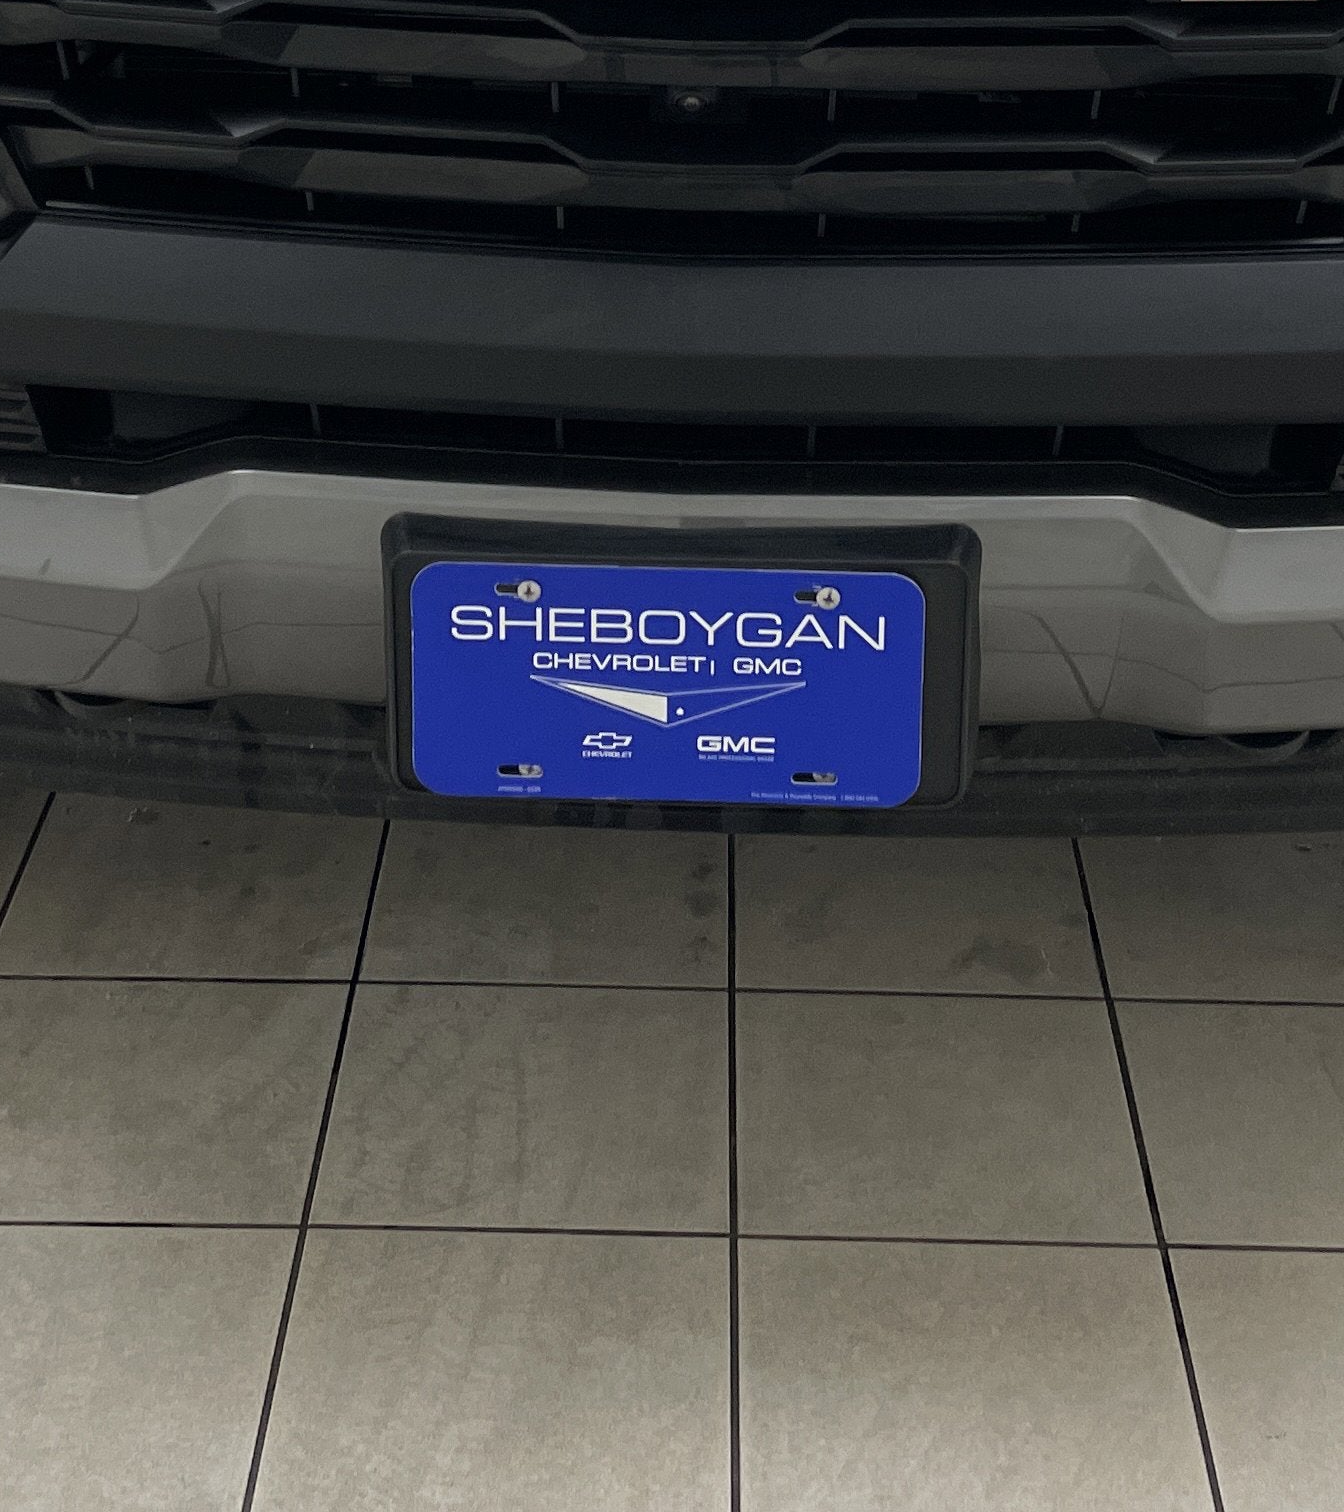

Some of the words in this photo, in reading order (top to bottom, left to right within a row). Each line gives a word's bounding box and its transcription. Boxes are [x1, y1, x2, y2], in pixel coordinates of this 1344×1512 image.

[450, 604, 886, 652] SHEBOYGAN
[532, 651, 707, 674] CHEVROLET
[732, 656, 802, 676] GMC
[696, 735, 776, 754] GMC
